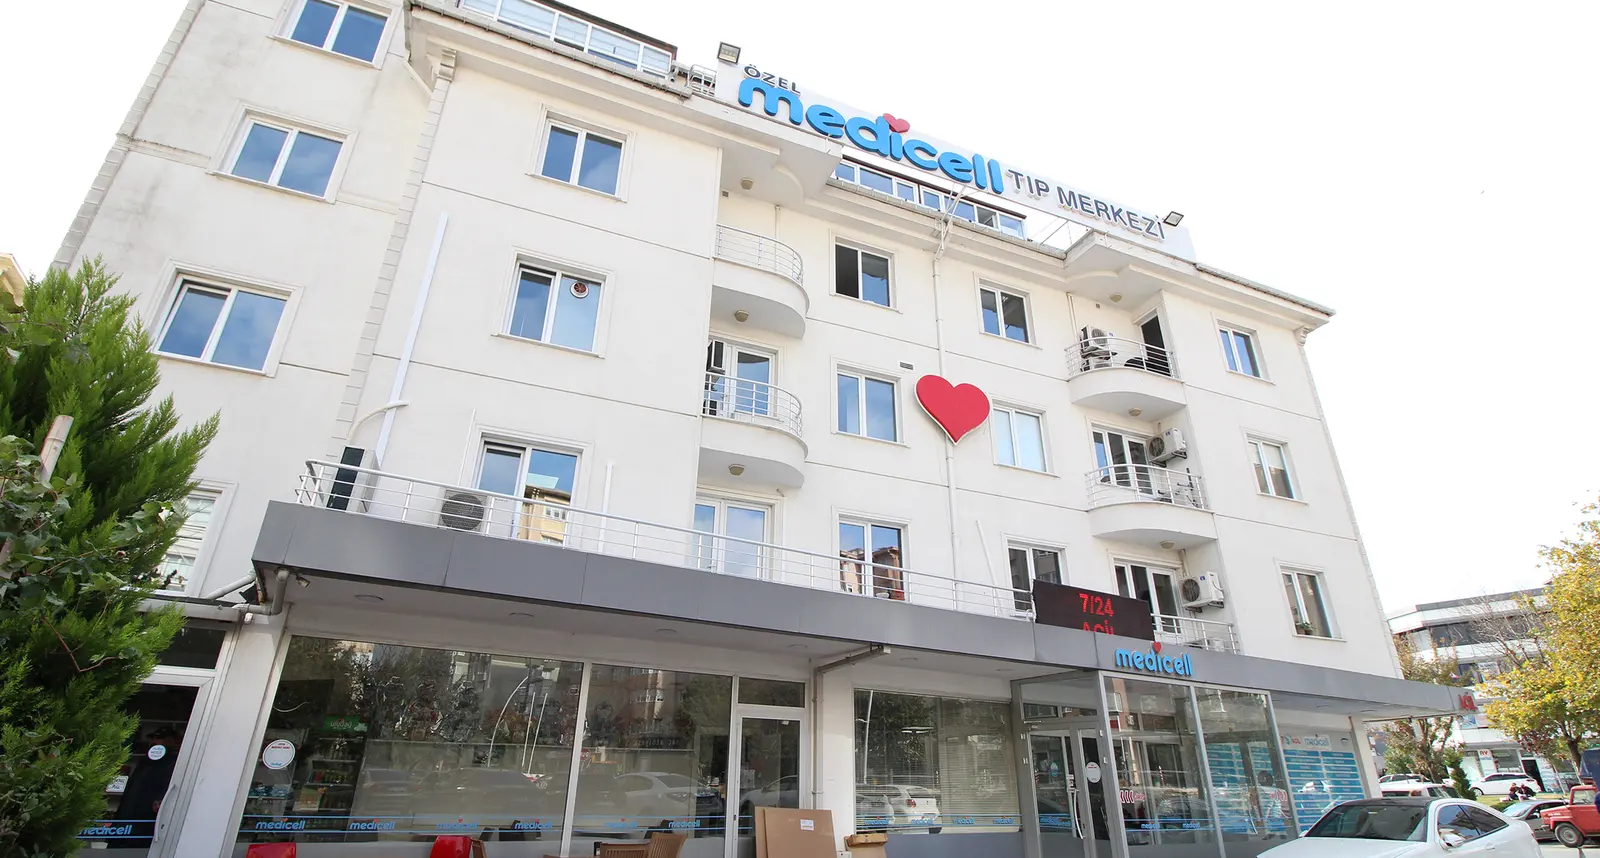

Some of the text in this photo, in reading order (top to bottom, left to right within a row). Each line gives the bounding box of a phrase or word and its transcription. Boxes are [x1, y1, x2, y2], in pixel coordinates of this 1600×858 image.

[743, 63, 801, 95] ÖZEL
[738, 77, 1005, 195] medicell
[1007, 169, 1166, 240] TIP MERKEZİ
[1079, 592, 1115, 617] 7/24
[1115, 641, 1193, 677] medicell
[256, 818, 306, 830] medicell
[350, 818, 395, 830] medicell
[669, 818, 701, 828] medicell
